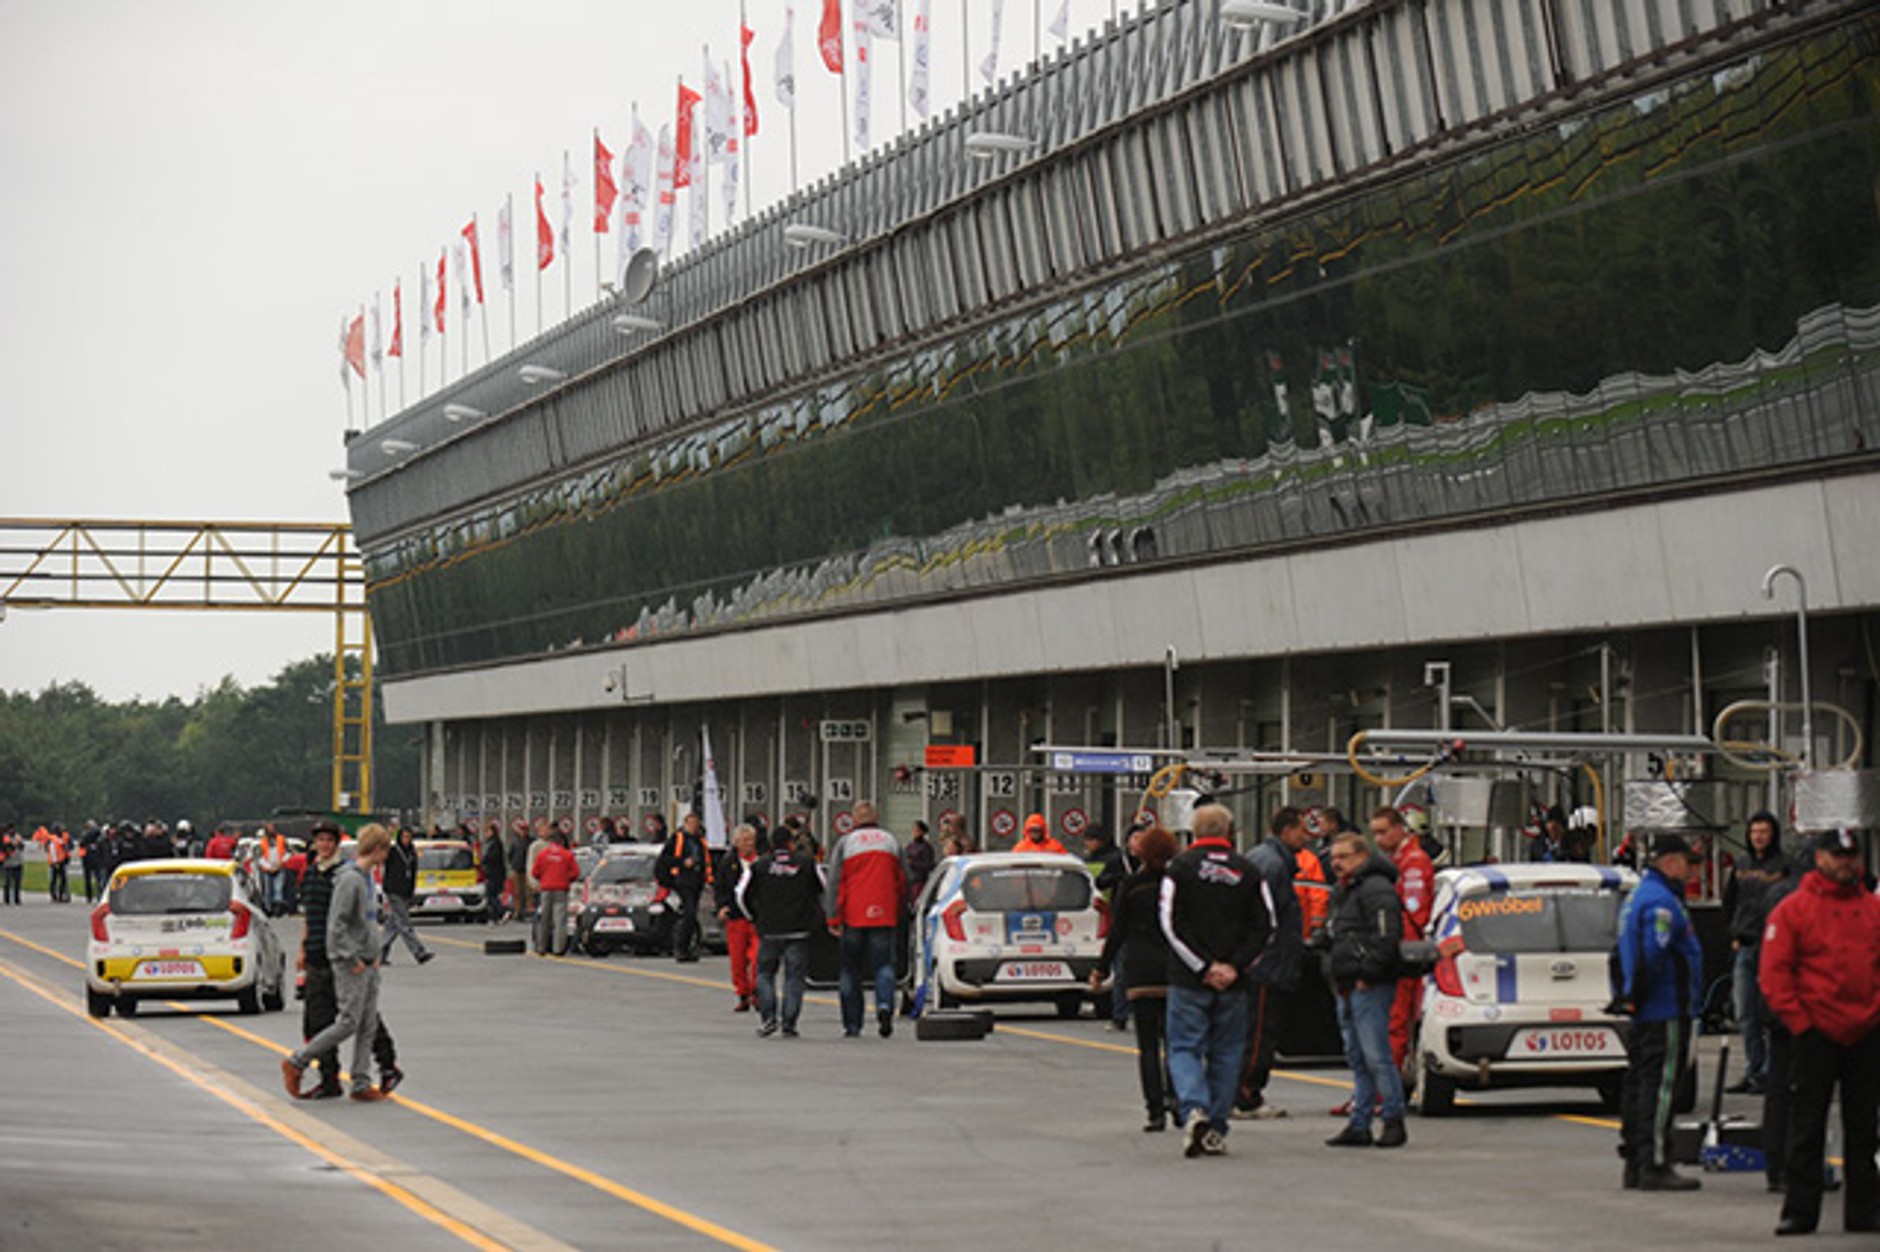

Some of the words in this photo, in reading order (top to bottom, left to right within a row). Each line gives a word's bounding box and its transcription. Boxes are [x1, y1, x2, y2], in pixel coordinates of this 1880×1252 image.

[832, 781, 850, 798] 14
[993, 776, 1013, 795] 12
[1024, 964, 1062, 977] LOTOS
[1551, 1032, 1607, 1051] LOTOS
